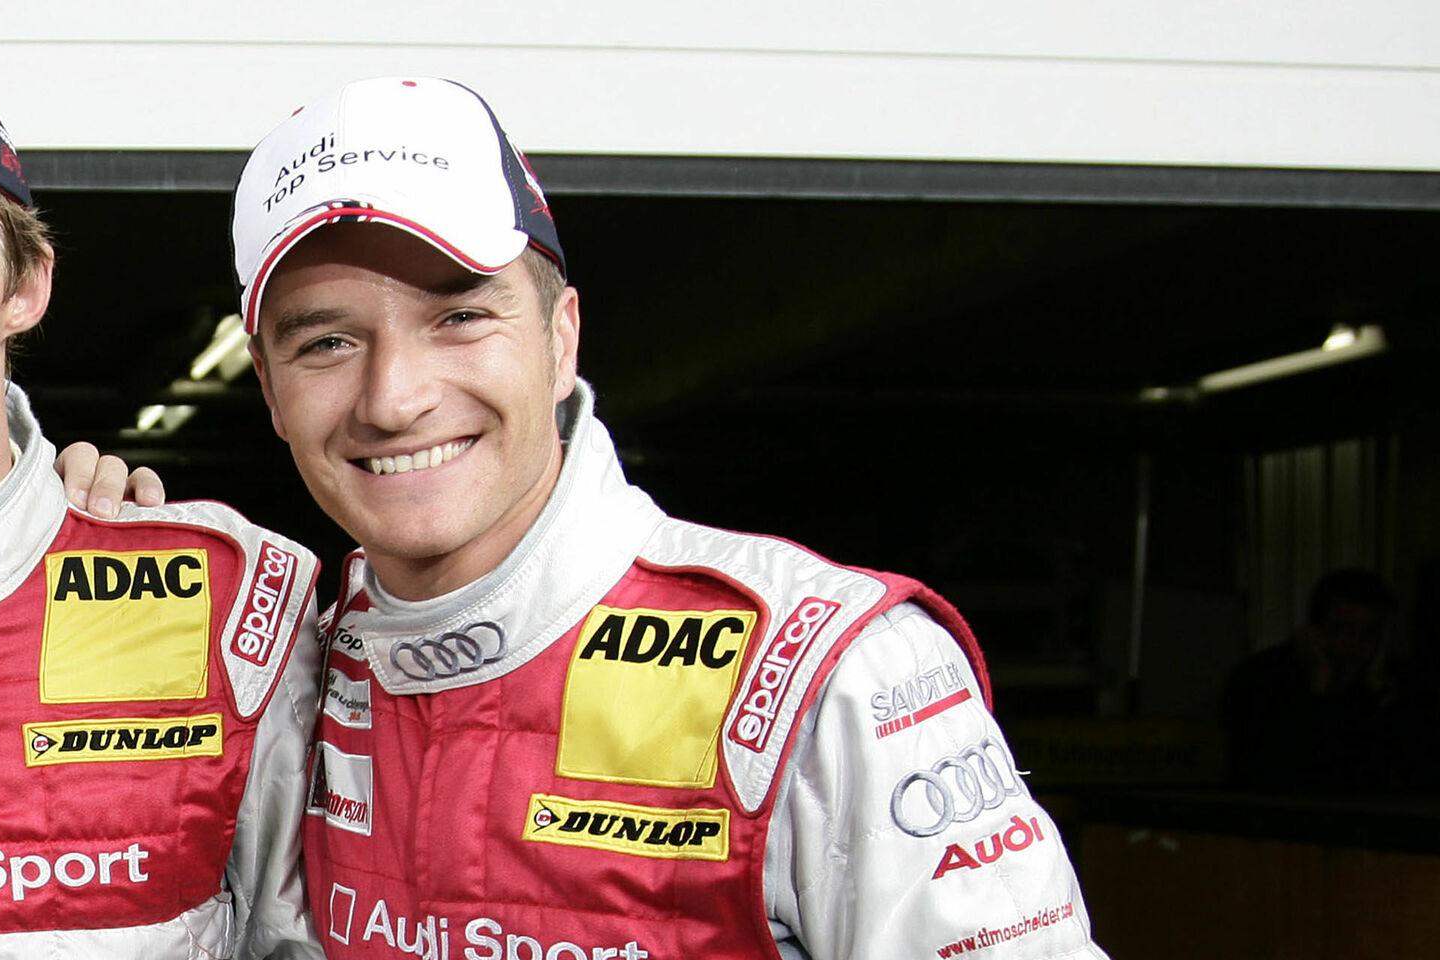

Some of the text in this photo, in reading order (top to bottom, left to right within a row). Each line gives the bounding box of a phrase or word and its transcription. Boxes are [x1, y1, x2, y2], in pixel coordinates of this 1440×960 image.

[262, 146, 450, 214] Top Service
[274, 132, 336, 188] Audi
[54, 555, 203, 601] ADAC
[237, 546, 292, 659] sparco
[334, 627, 363, 651] Top
[579, 614, 745, 669] ADAC
[737, 601, 833, 744] sparco
[58, 724, 217, 753] DUNLOP
[558, 811, 721, 847] DUNLOP
[931, 815, 1045, 881] Audi
